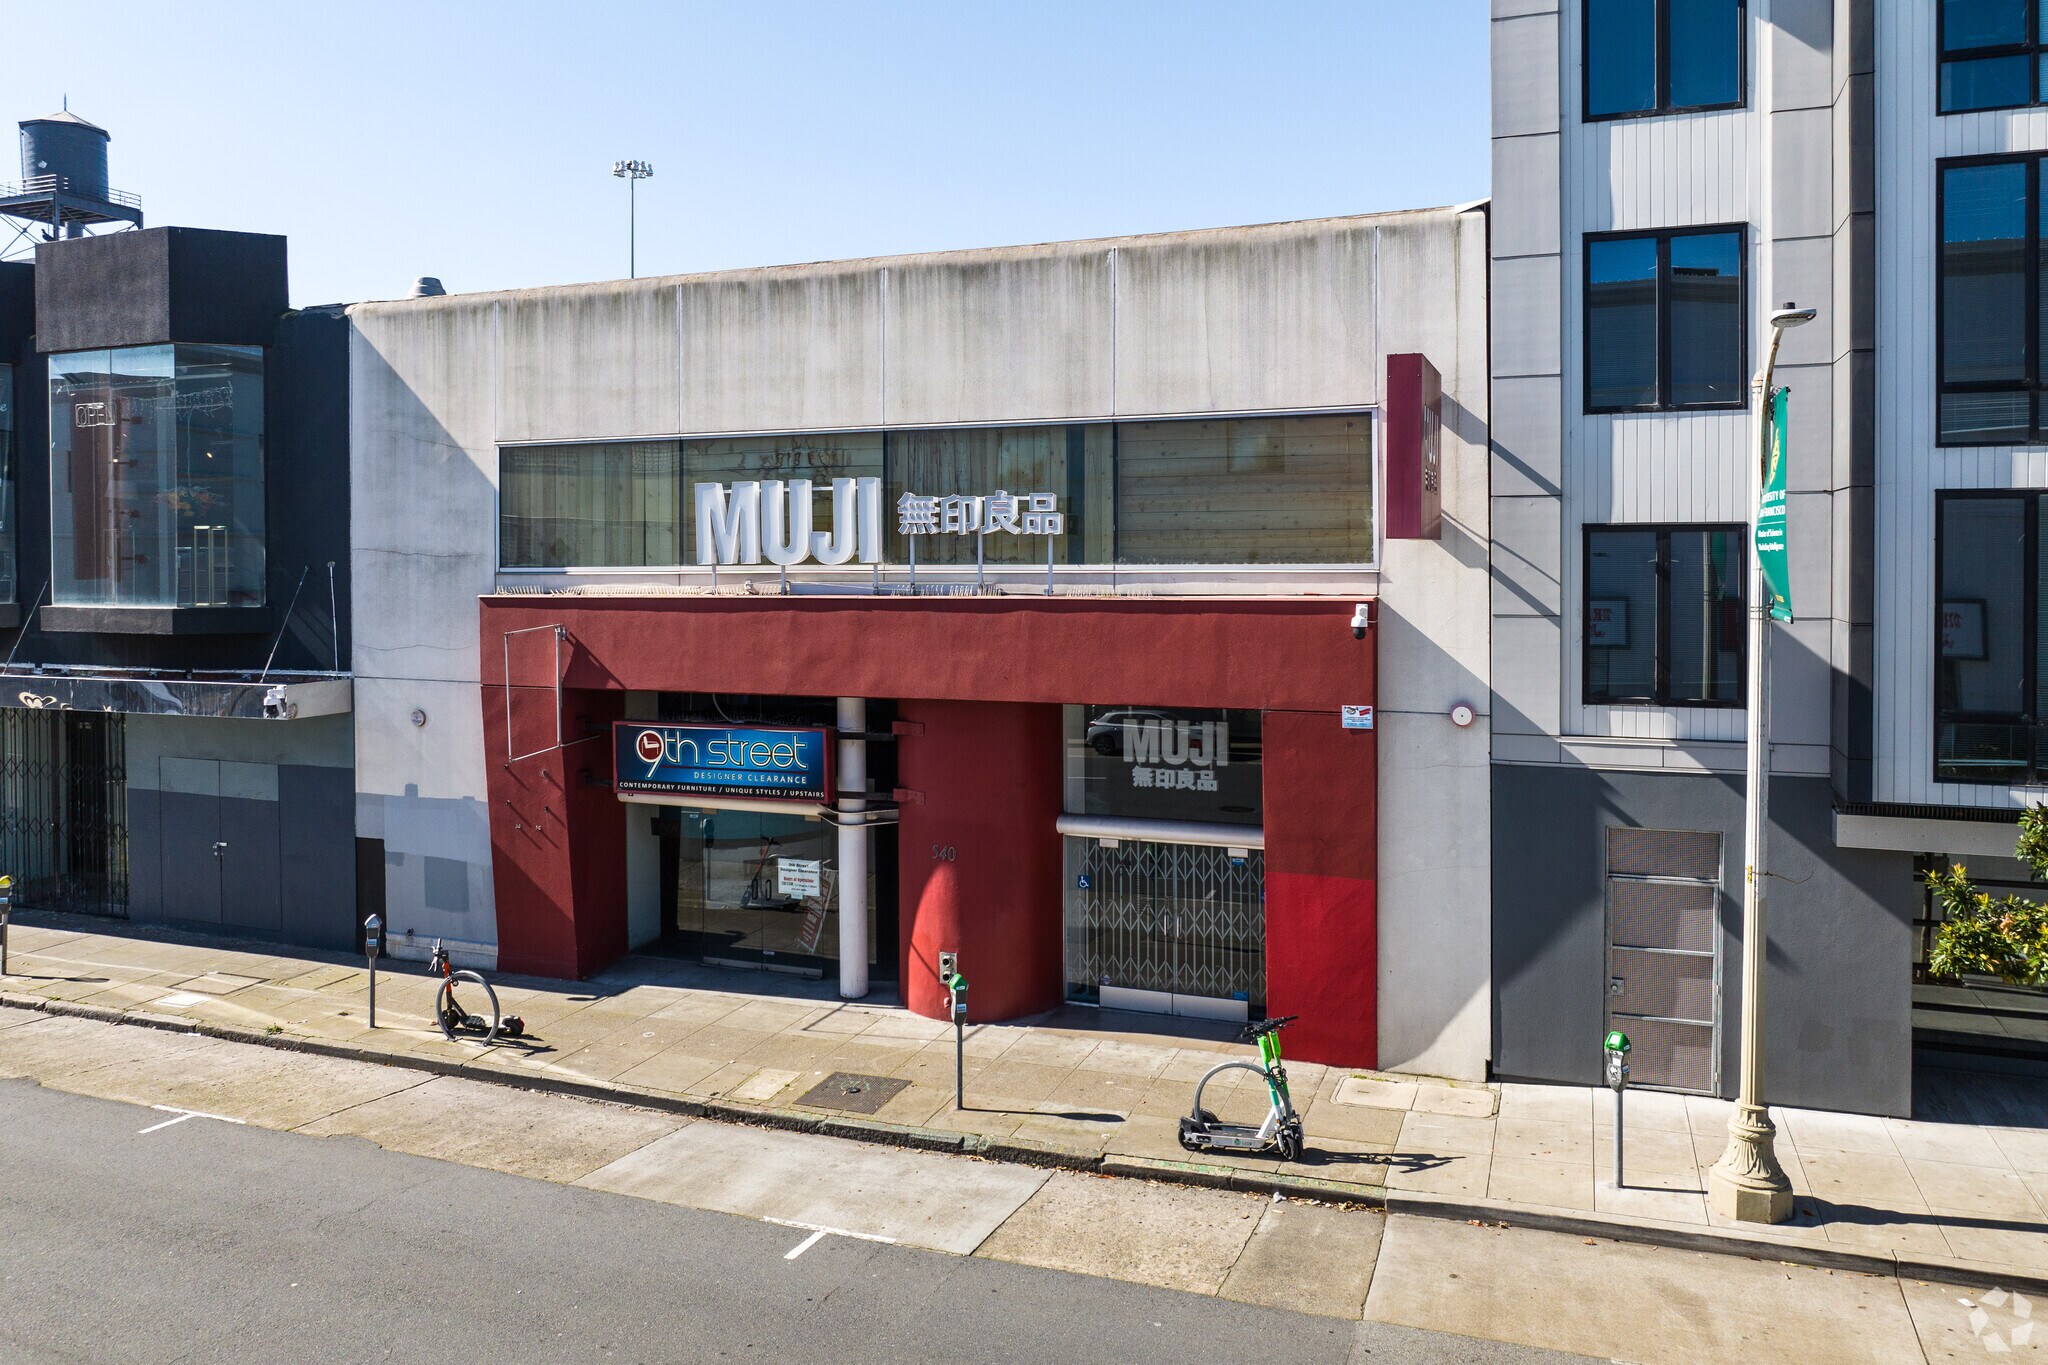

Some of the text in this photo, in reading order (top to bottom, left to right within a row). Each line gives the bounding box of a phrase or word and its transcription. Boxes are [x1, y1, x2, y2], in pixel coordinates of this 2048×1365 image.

[694, 476, 884, 566] MUJI
[896, 489, 1065, 537] 無印良品
[635, 729, 808, 779] 9th street
[1122, 718, 1229, 767] MUJI
[619, 781, 675, 790] CONTEMPORARY
[677, 784, 717, 793] FURNITURE
[725, 786, 753, 795] UNIQUE
[755, 788, 781, 796] STYLES
[789, 790, 825, 798] UPSTAIRS
[694, 771, 807, 785] DESIGNER CLEARANCE
[1131, 765, 1218, 792] 無印良品
[930, 844, 957, 862] 540
